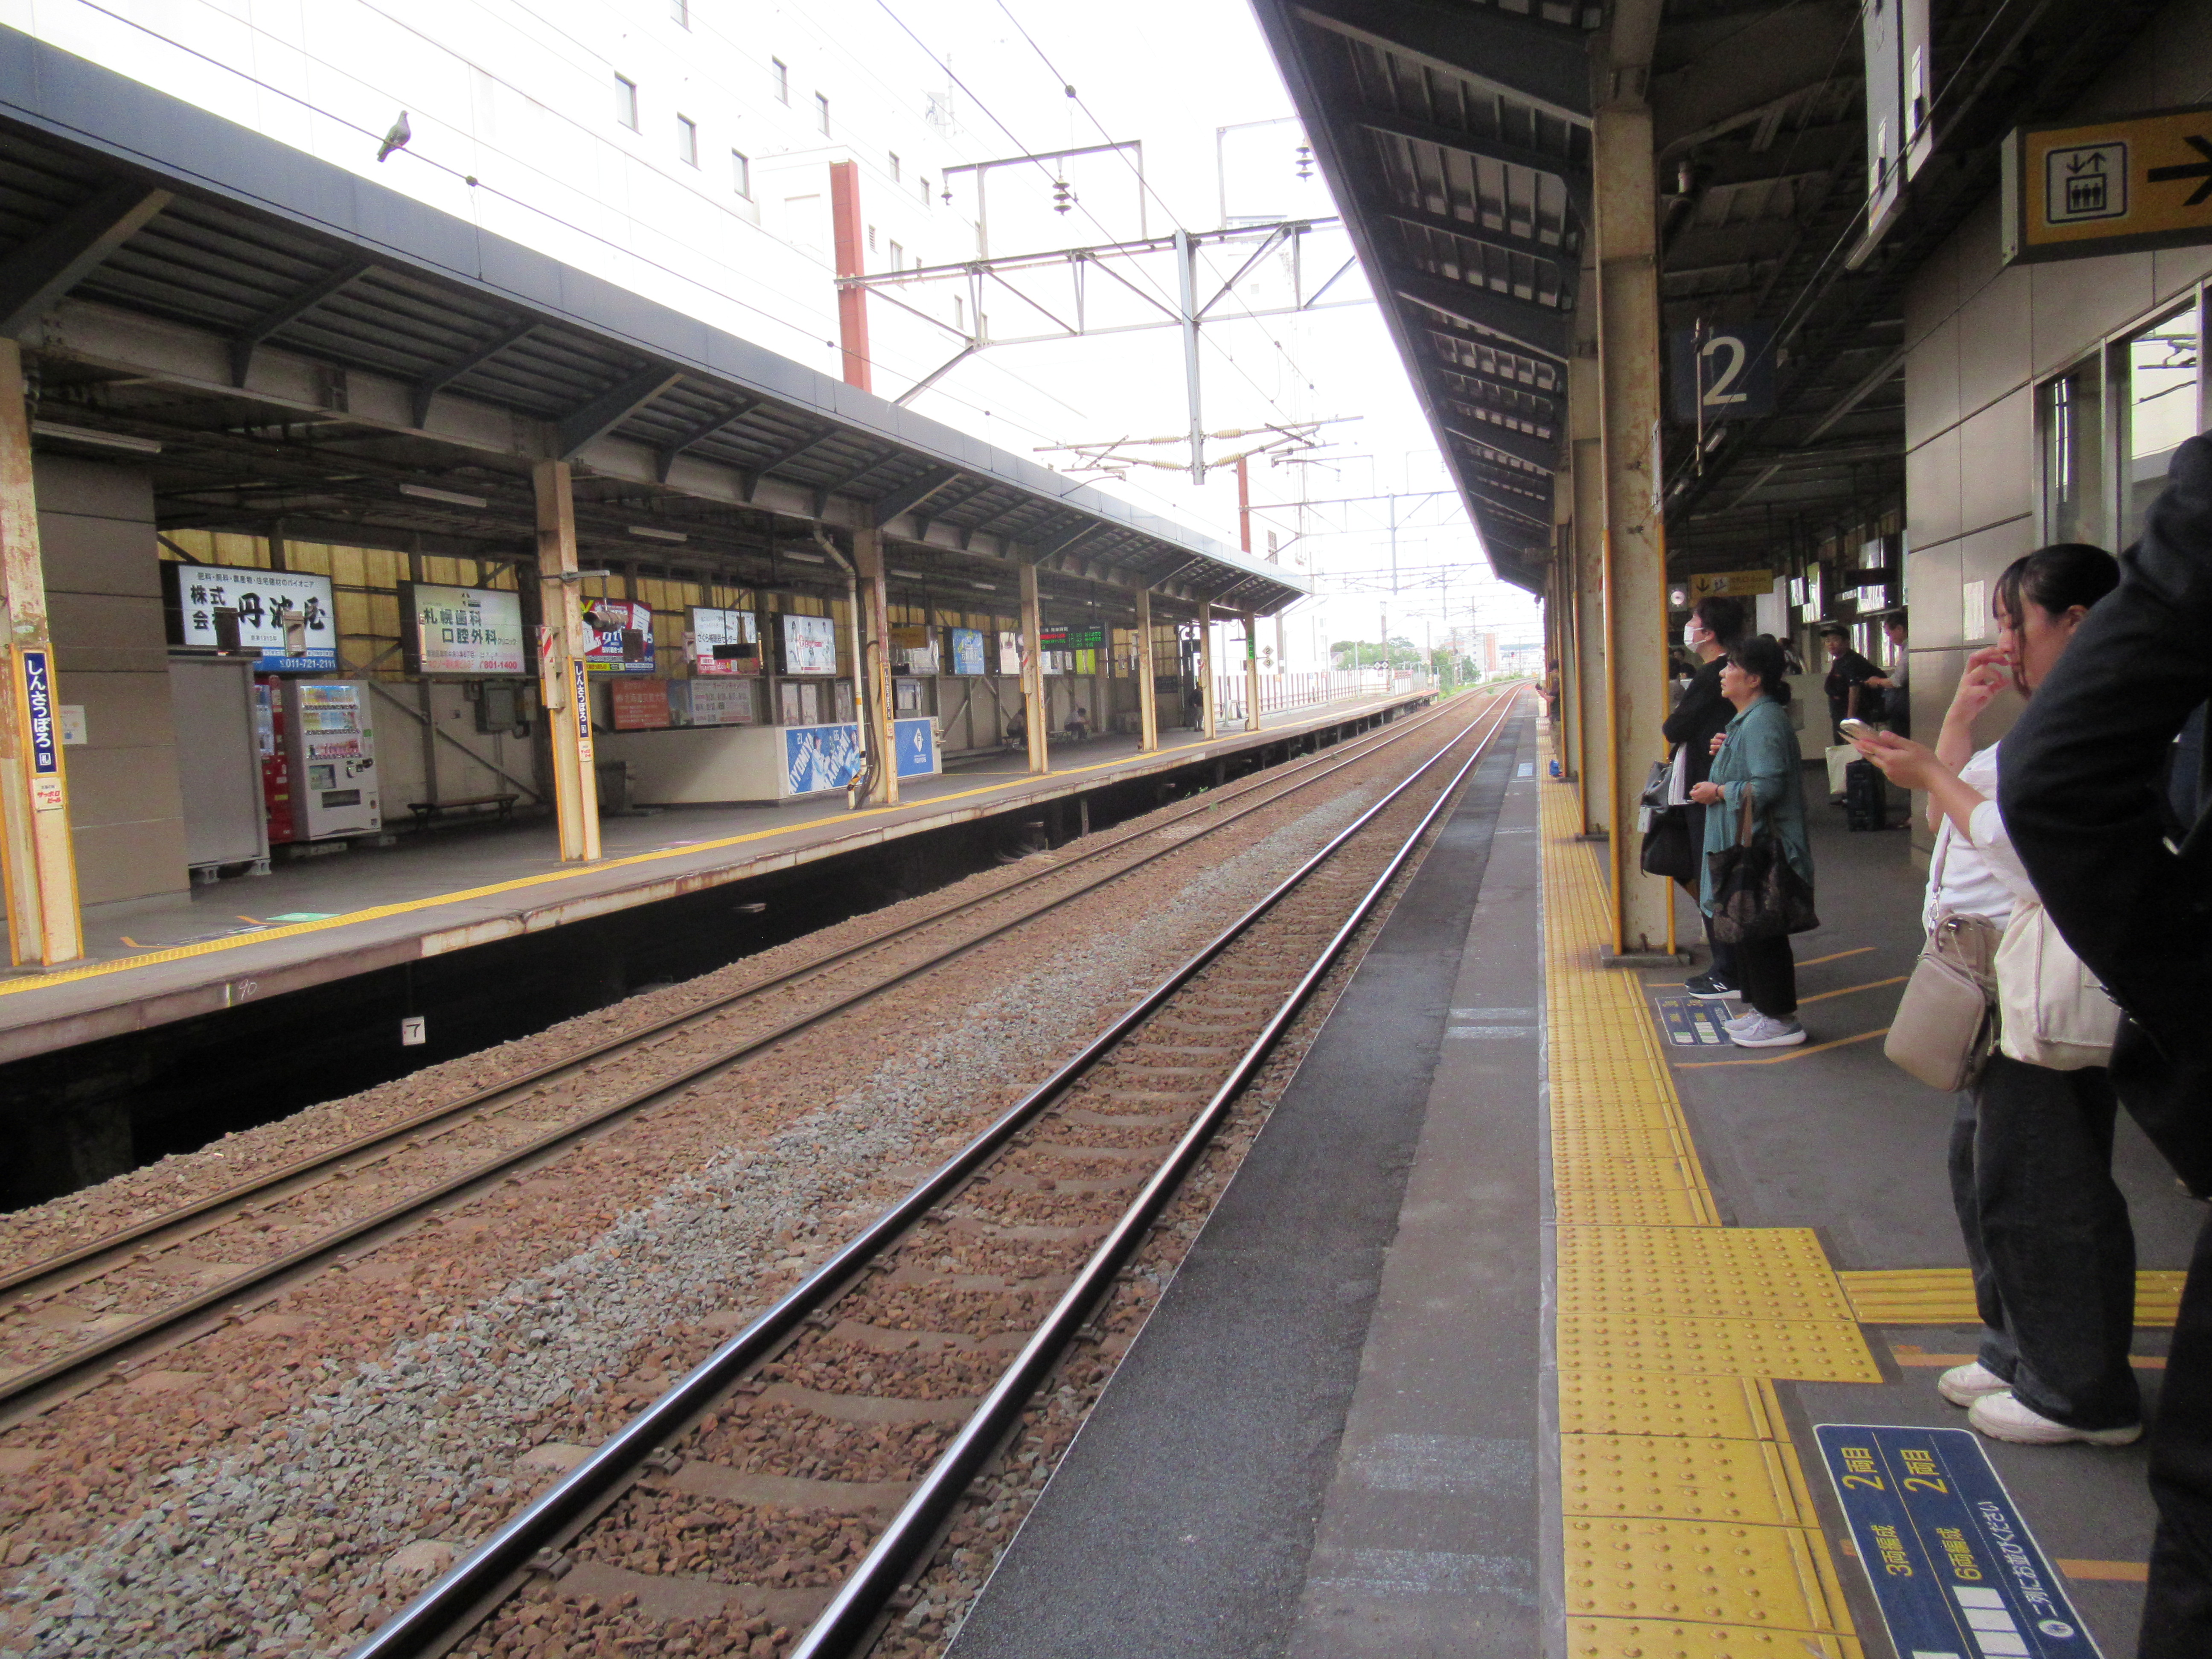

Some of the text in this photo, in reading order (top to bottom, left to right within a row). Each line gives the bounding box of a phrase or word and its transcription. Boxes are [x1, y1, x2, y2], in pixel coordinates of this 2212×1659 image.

[1702, 336, 1747, 406] 2
[285, 658, 336, 669] 011-721-2111
[797, 733, 803, 745] 21
[406, 1023, 422, 1038] 7
[1841, 1447, 1913, 1577] 3両編成 2両目
[1900, 1449, 1982, 1580] 6両編成 2両目
[1977, 1501, 2058, 1617] 二列にお並びください
